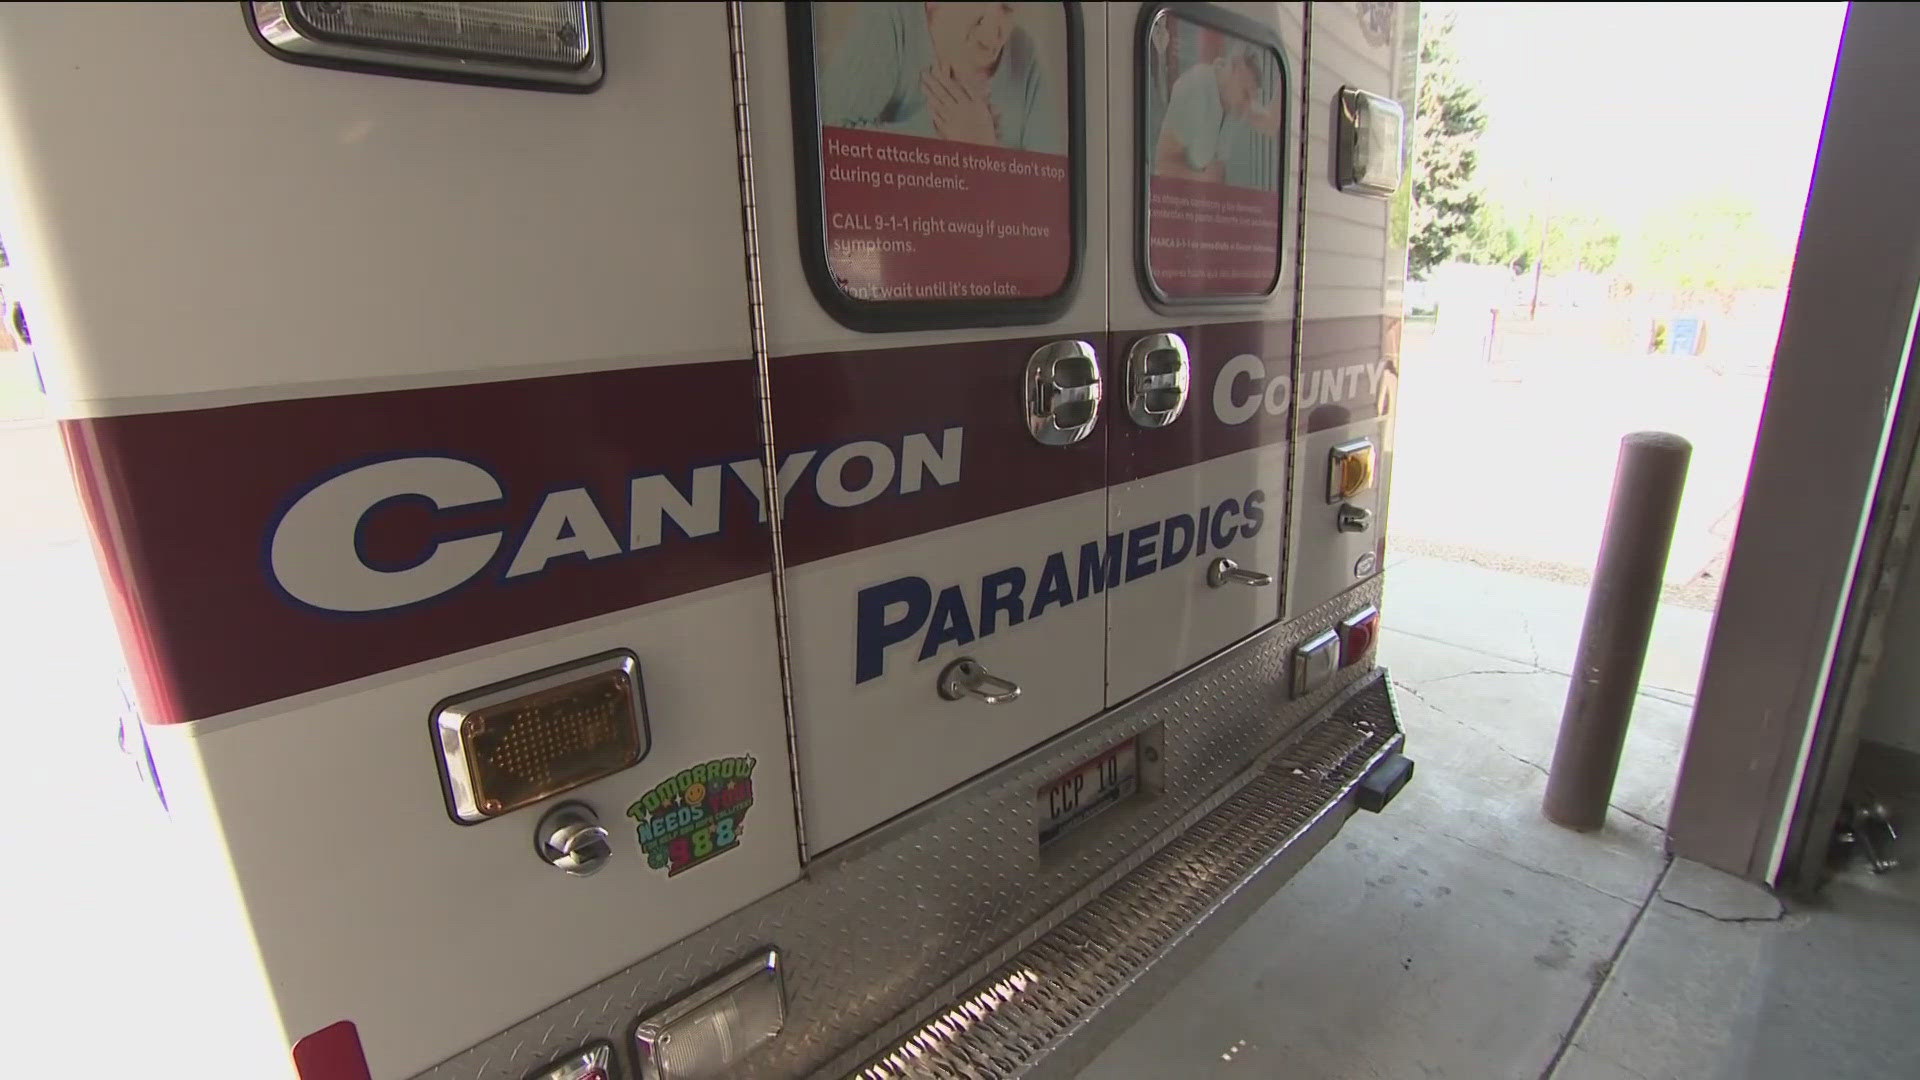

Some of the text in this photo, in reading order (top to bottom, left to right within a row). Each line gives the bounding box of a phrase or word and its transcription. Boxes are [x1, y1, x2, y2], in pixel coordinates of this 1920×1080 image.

[828, 139, 1065, 182] Heart attacks and strokes don't stop
[829, 164, 969, 191] during a pandemic.
[832, 213, 1050, 238] CALL 9-1-1 right away if you have
[833, 237, 916, 256] symptoms.
[845, 280, 1020, 299] on't wait until it's too late.
[270, 354, 1387, 612] CANYON COUNTY
[856, 490, 1266, 684] PARAMEDICS
[628, 758, 755, 821] TOMORROW
[1050, 773, 1083, 820] CCP
[638, 806, 705, 846] NEEDS
[669, 818, 736, 864] 988
